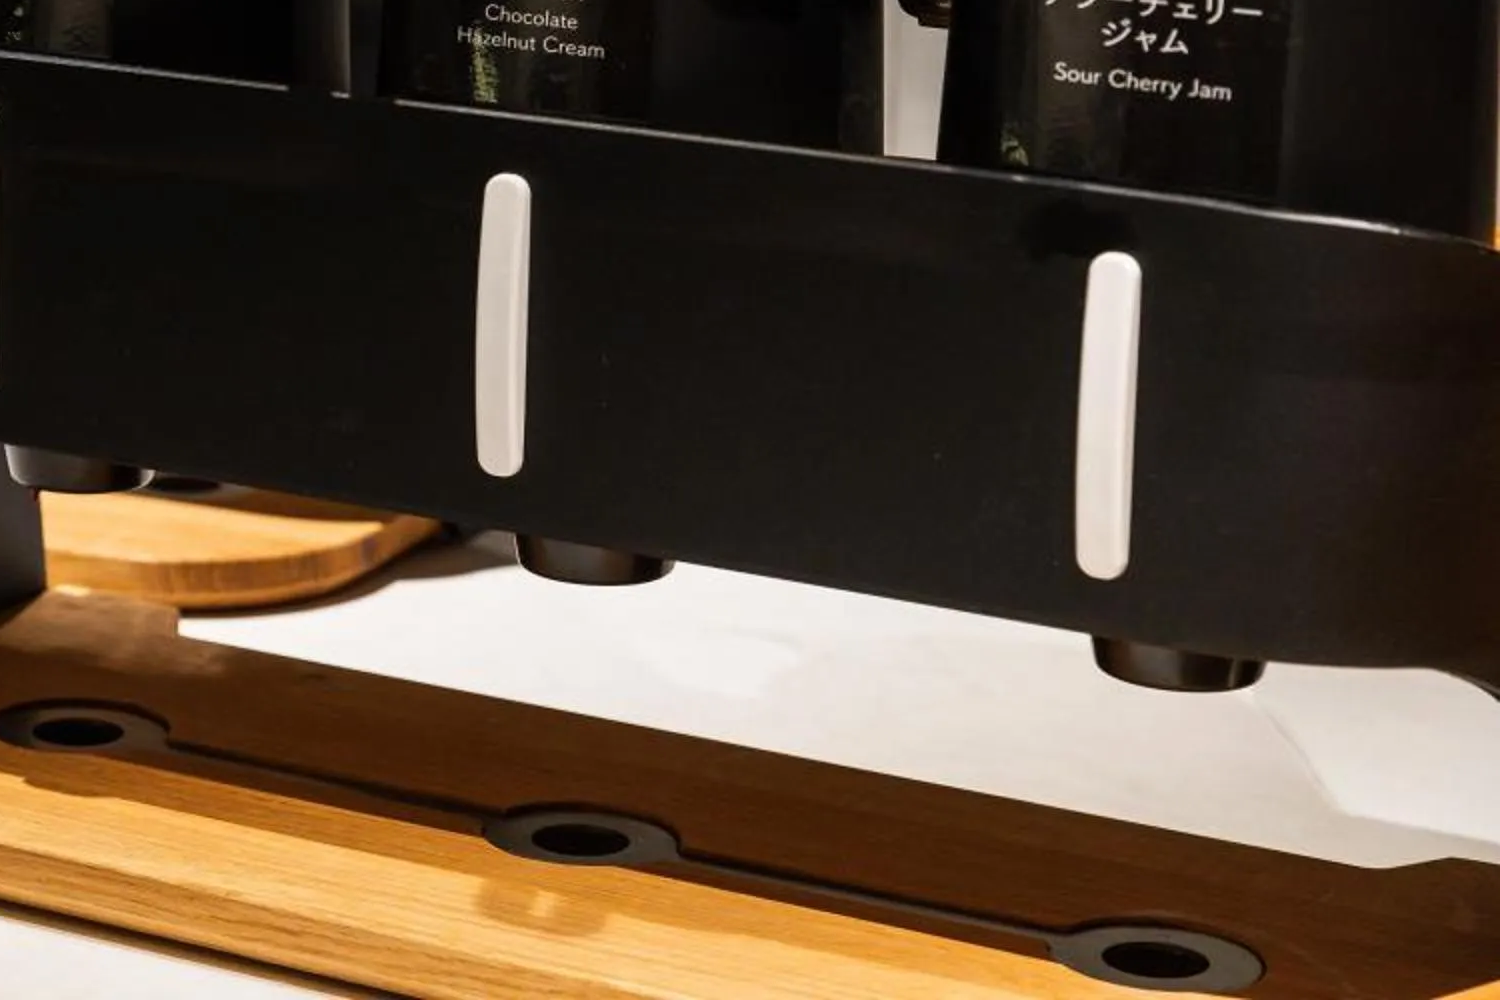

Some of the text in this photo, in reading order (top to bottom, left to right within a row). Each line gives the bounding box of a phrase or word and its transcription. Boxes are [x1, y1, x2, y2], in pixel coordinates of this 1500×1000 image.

[484, 3, 579, 31] Chocolate
[456, 25, 606, 60] Hazelnut Cream
[1100, 17, 1189, 54] ジャム
[1053, 61, 1233, 102] Sour Cherry Jam
